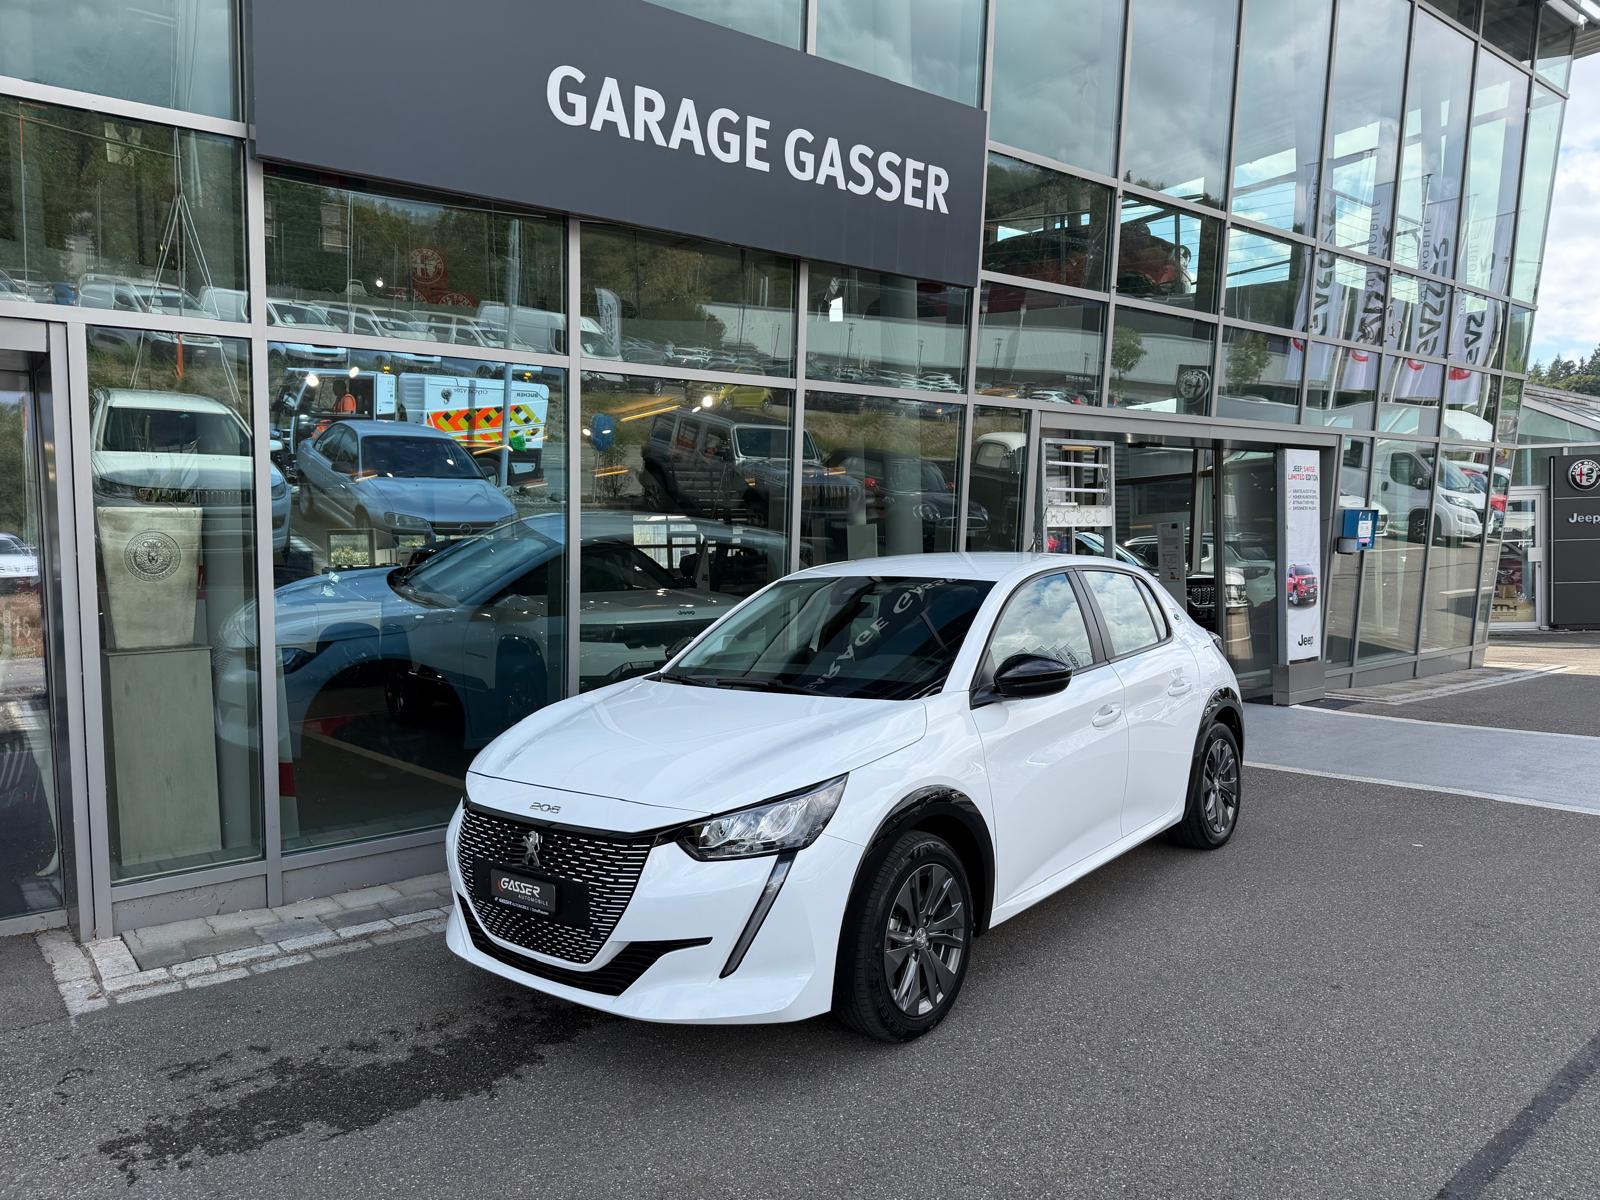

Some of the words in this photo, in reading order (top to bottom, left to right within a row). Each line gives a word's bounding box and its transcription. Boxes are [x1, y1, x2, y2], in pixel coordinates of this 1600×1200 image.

[546, 65, 770, 173] GARAGE
[784, 128, 949, 214] GASSER
[1288, 473, 1305, 481] LIMITED
[1568, 512, 1600, 525] Jeep
[1297, 634, 1314, 647] Jeep
[530, 802, 561, 814] 208
[500, 877, 540, 898] GASSER
[518, 894, 549, 906] AUTOMOBILE
